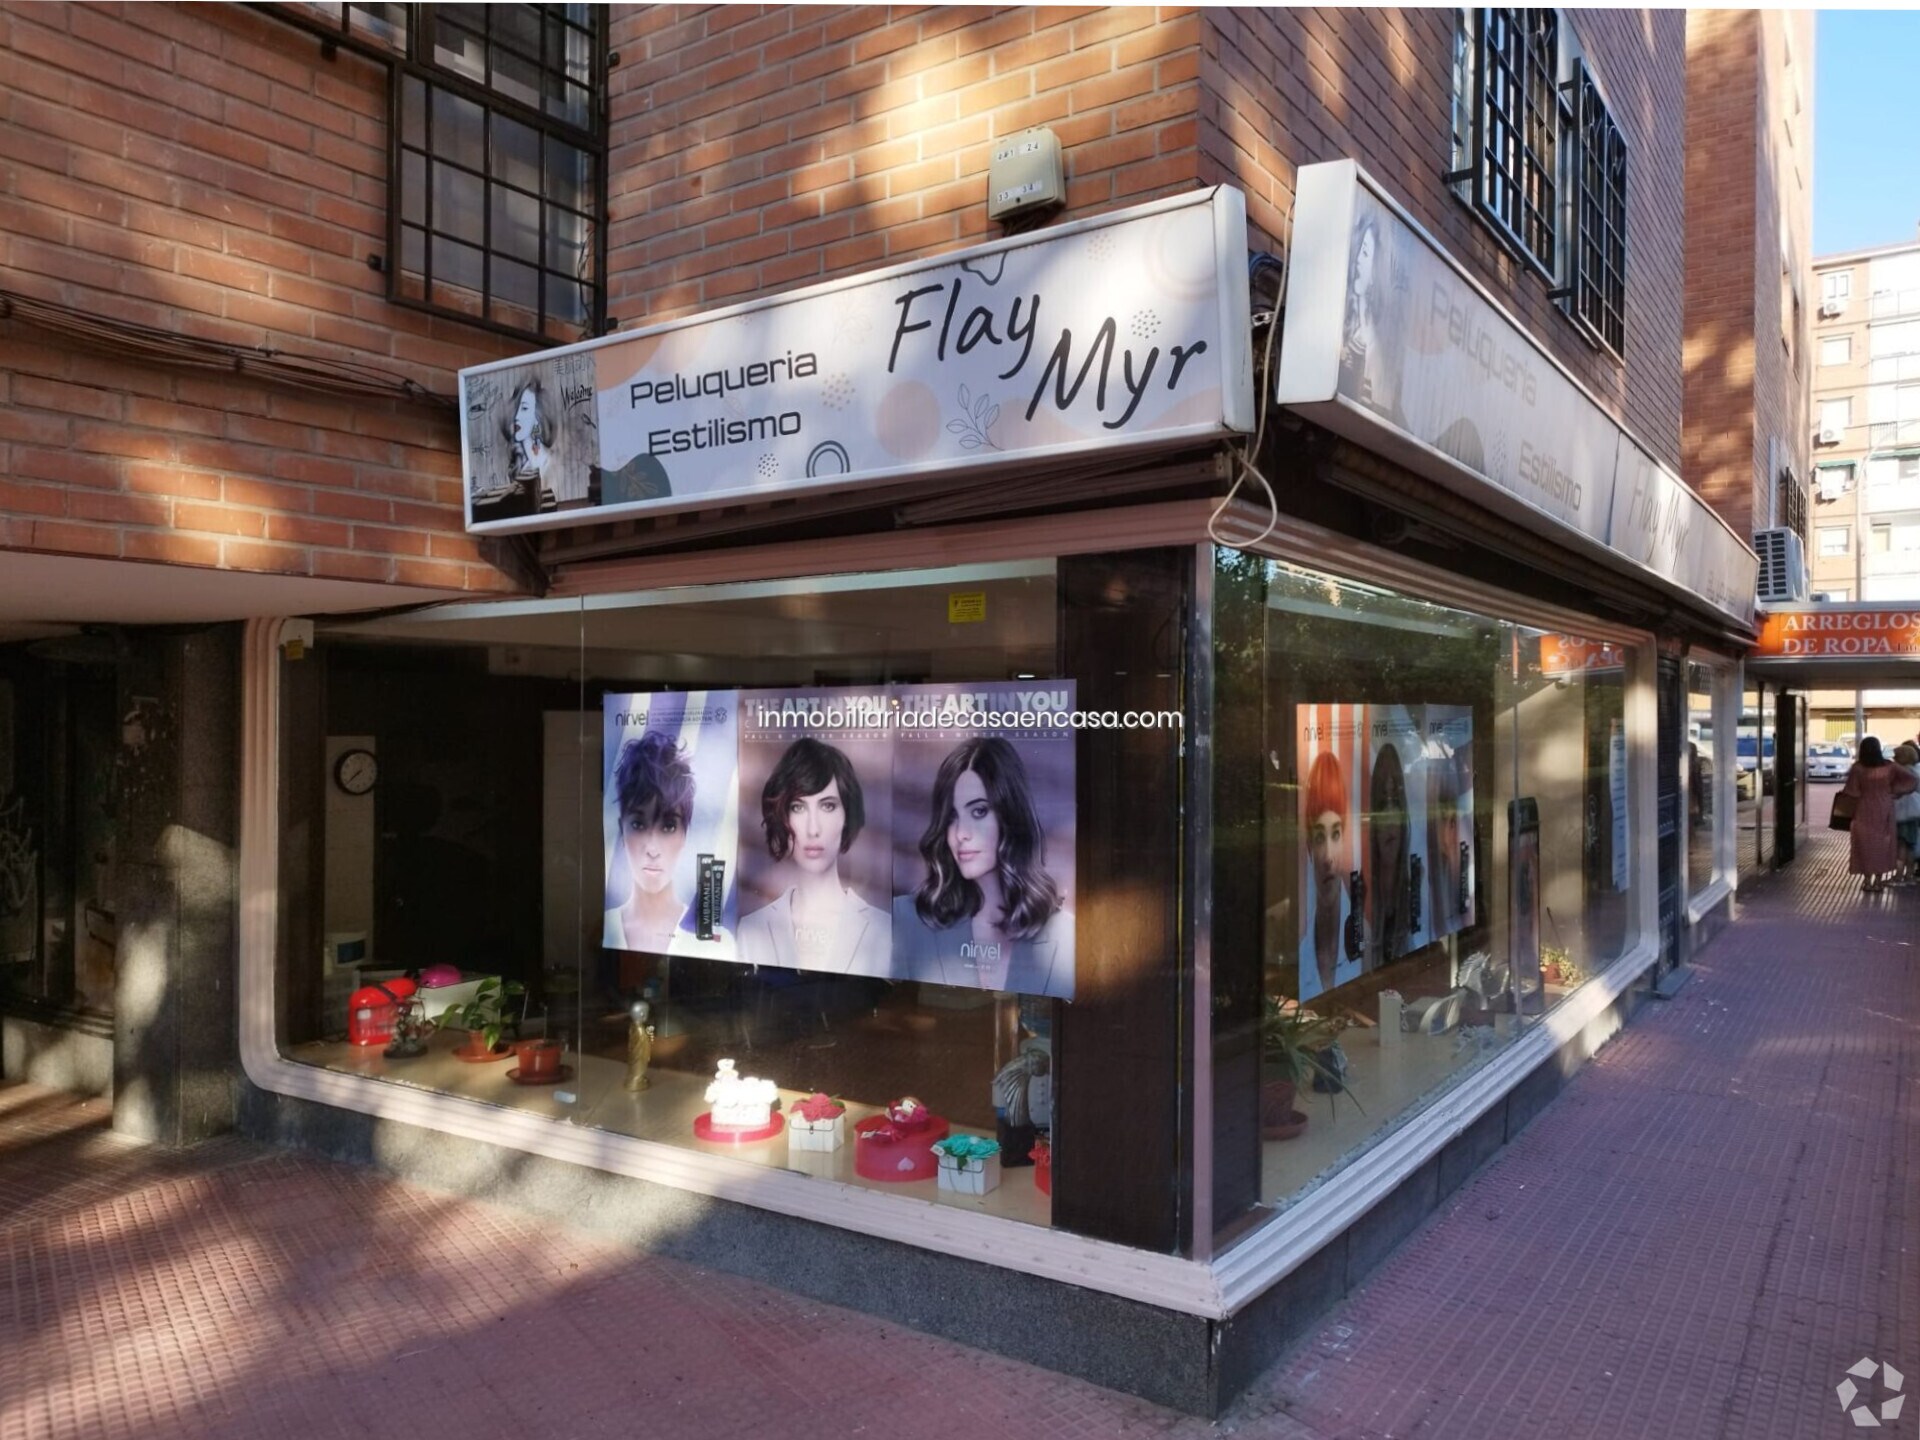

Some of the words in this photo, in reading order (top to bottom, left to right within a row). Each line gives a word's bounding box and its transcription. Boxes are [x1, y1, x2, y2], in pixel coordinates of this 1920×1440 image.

[888, 277, 1041, 380] Flay
[1431, 280, 1538, 408] Peluqueria
[630, 350, 818, 409] Peluqueria
[1024, 316, 1208, 430] Myr
[648, 411, 801, 457] Estilismo
[1518, 439, 1582, 512] Estilismo
[1782, 637, 1819, 654] DE
[1825, 636, 1893, 654] ROPA
[615, 710, 649, 726] nirvel
[1017, 690, 1069, 712] YOU
[960, 940, 1001, 960] nirvel
